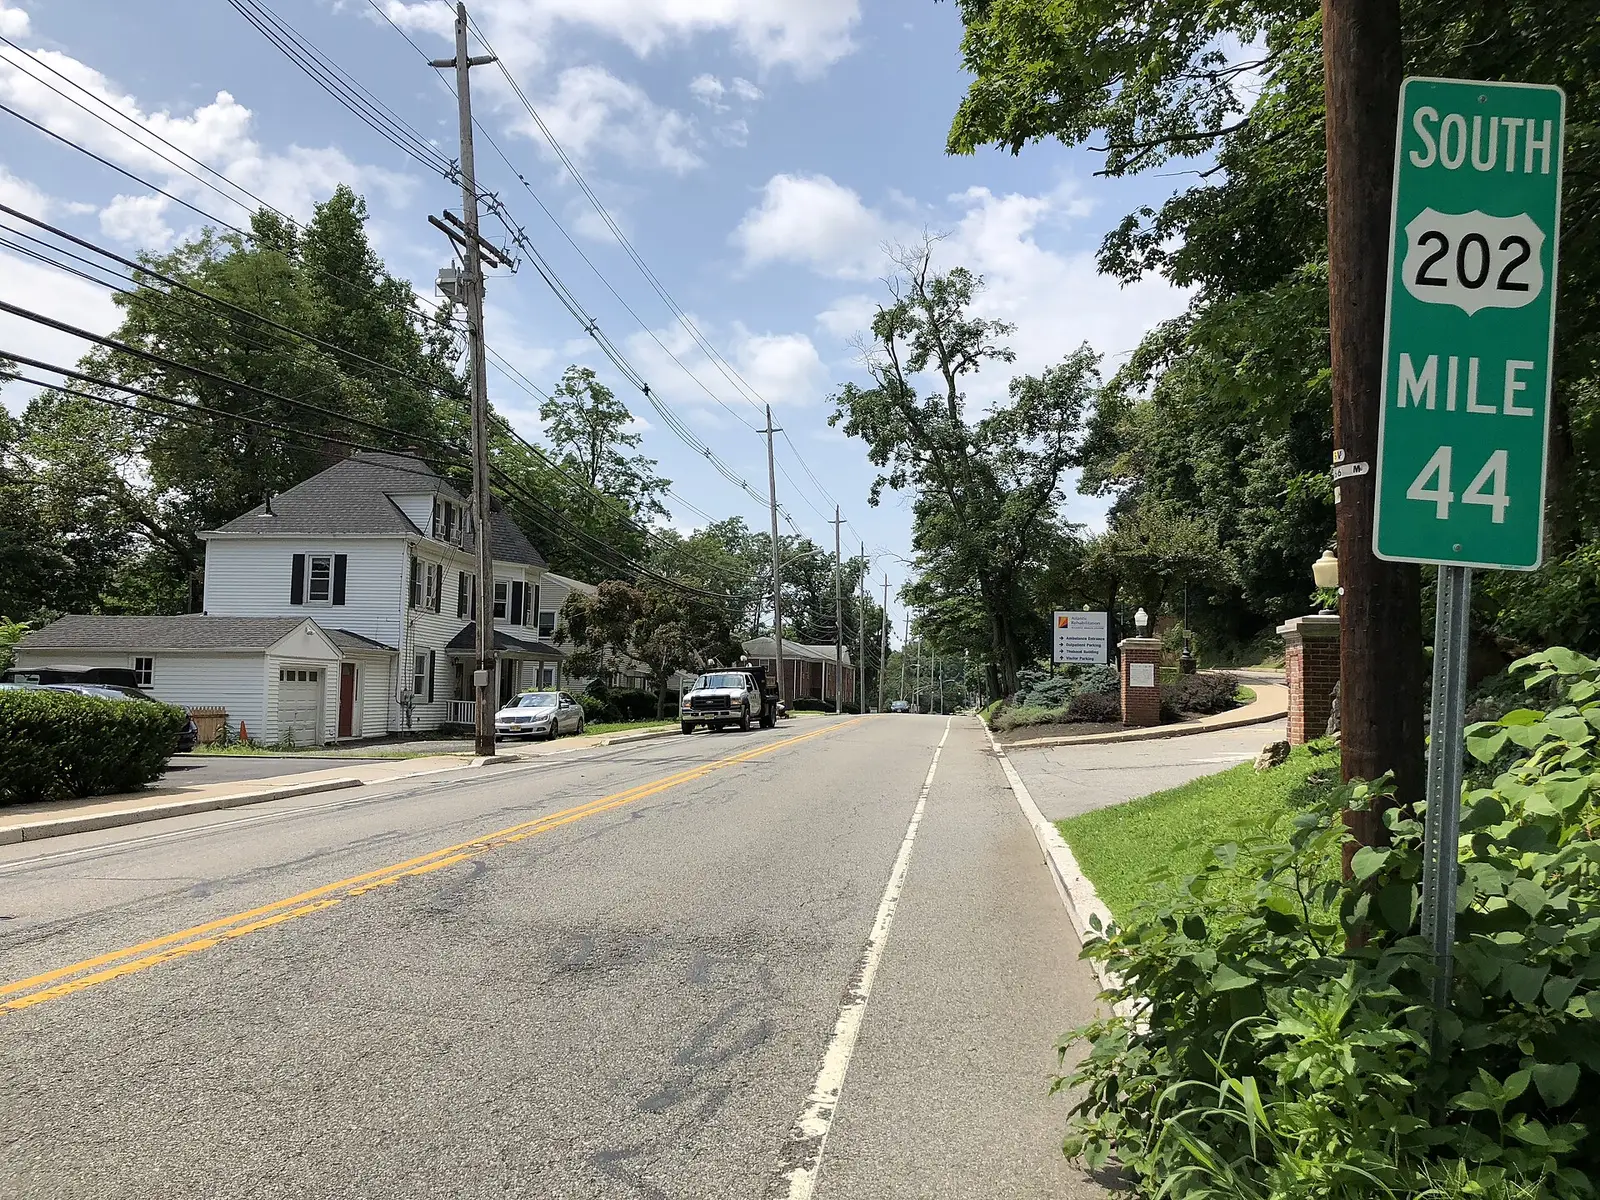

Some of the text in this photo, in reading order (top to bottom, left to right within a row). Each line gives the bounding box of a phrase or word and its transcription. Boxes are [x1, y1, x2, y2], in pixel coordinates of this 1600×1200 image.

[1410, 106, 1552, 174] SOUTH
[1415, 231, 1531, 292] 202
[1397, 353, 1534, 416] MILE
[1406, 446, 1510, 524] 44
